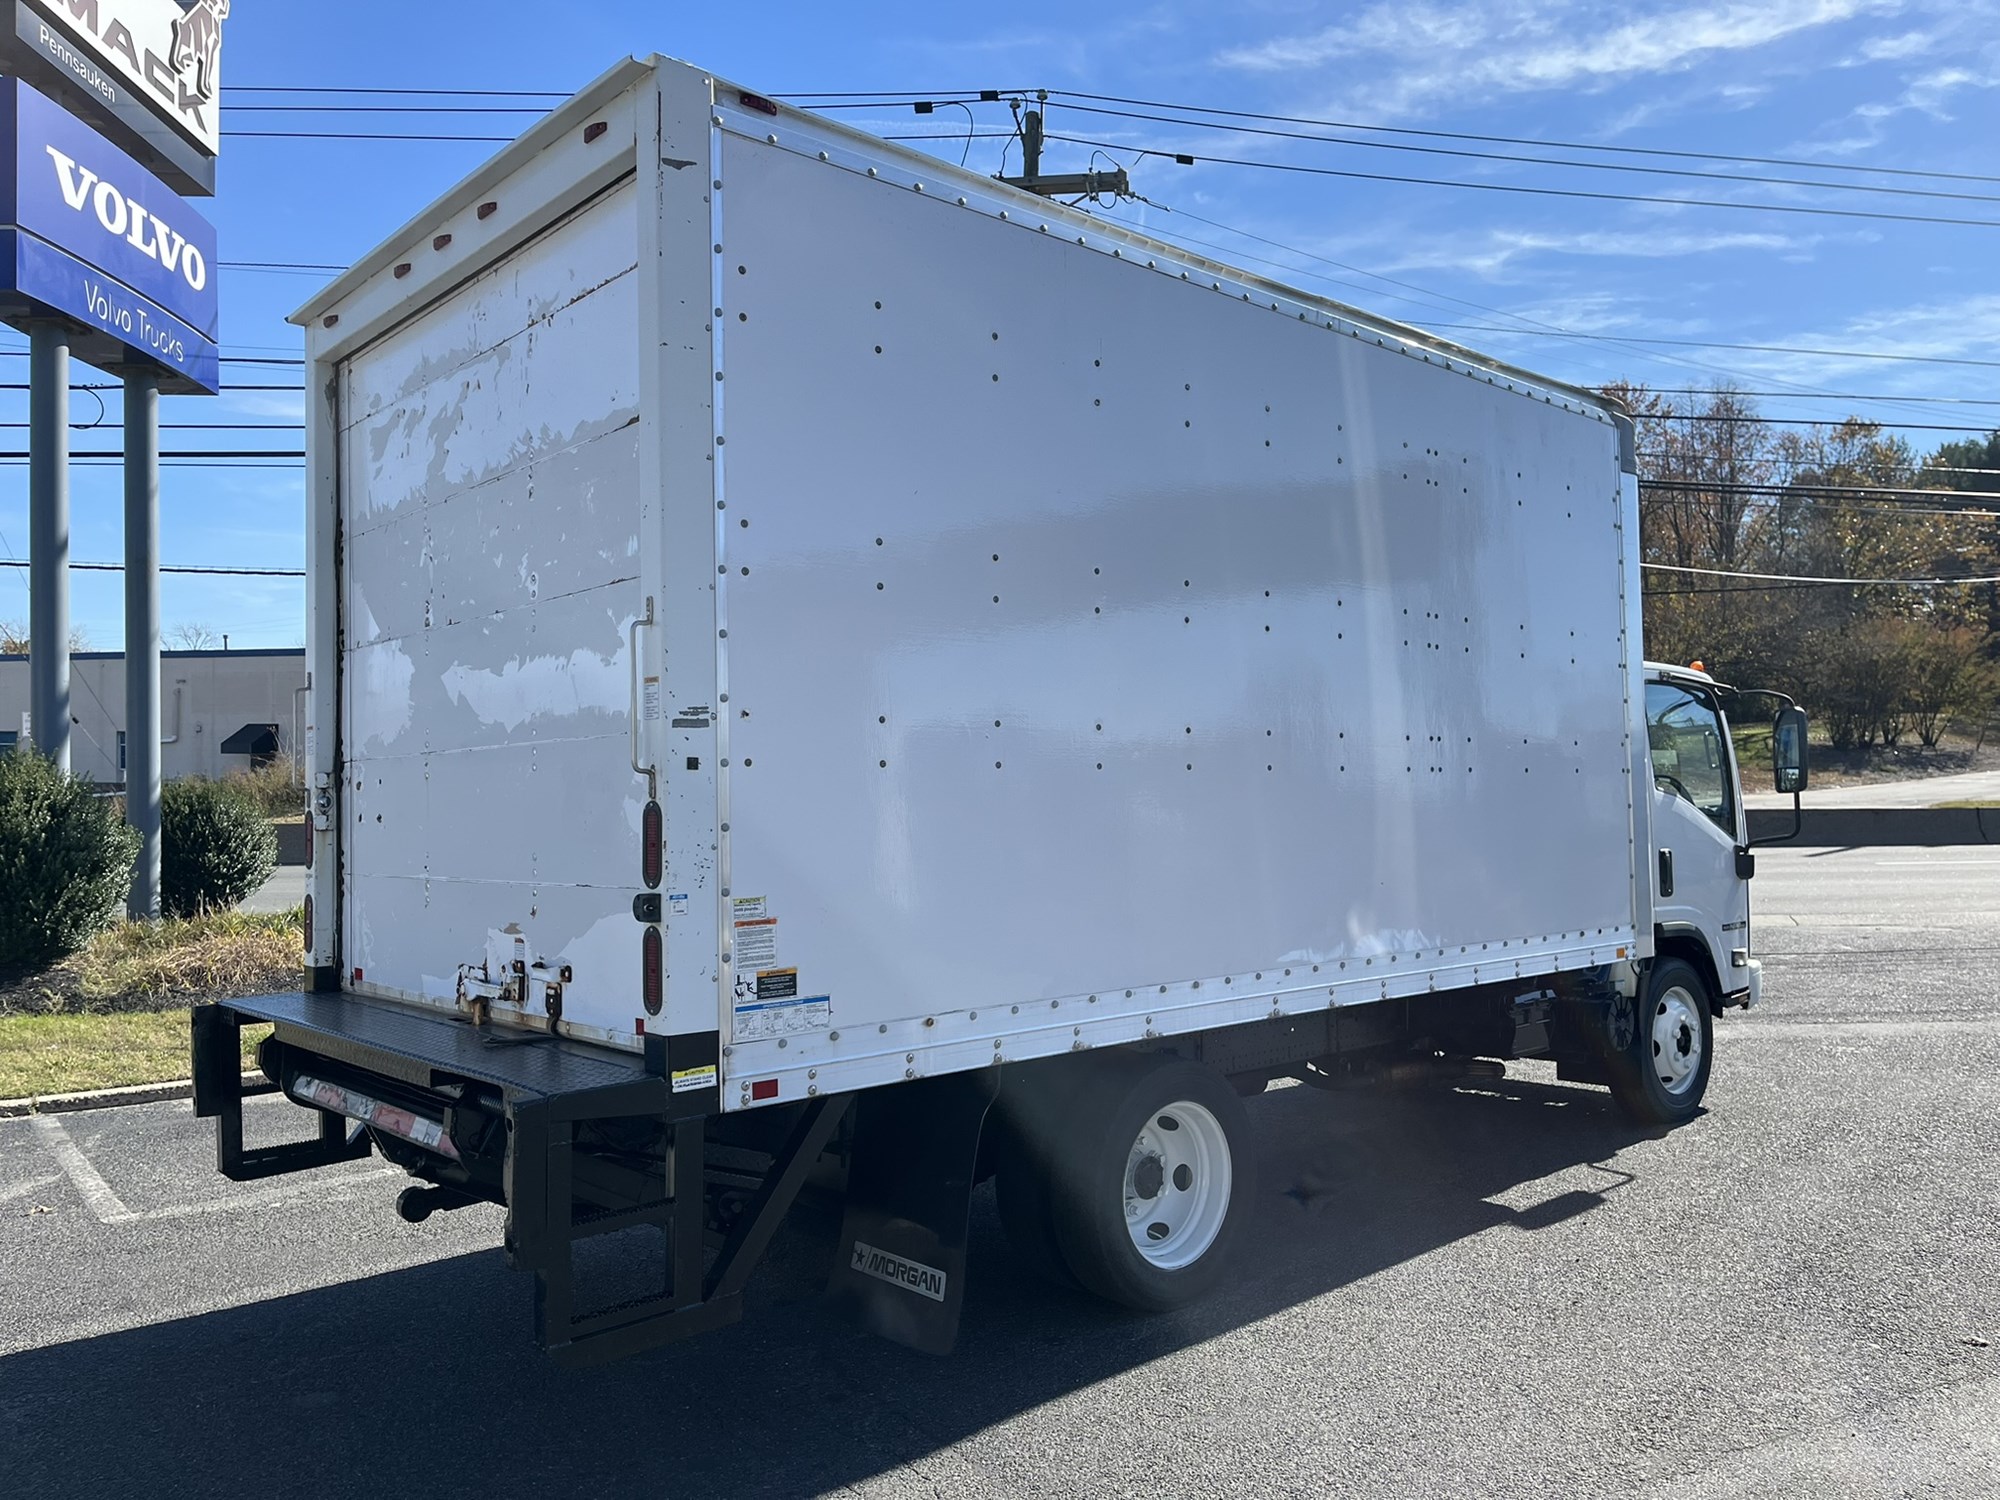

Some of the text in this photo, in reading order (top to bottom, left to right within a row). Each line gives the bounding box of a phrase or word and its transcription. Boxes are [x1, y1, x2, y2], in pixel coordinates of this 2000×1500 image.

[40, 24, 116, 103] Pennsauken
[46, 145, 206, 291] VOLVO
[84, 279, 184, 362] Volvo Trucks
[868, 1252, 942, 1295] MORGAN
